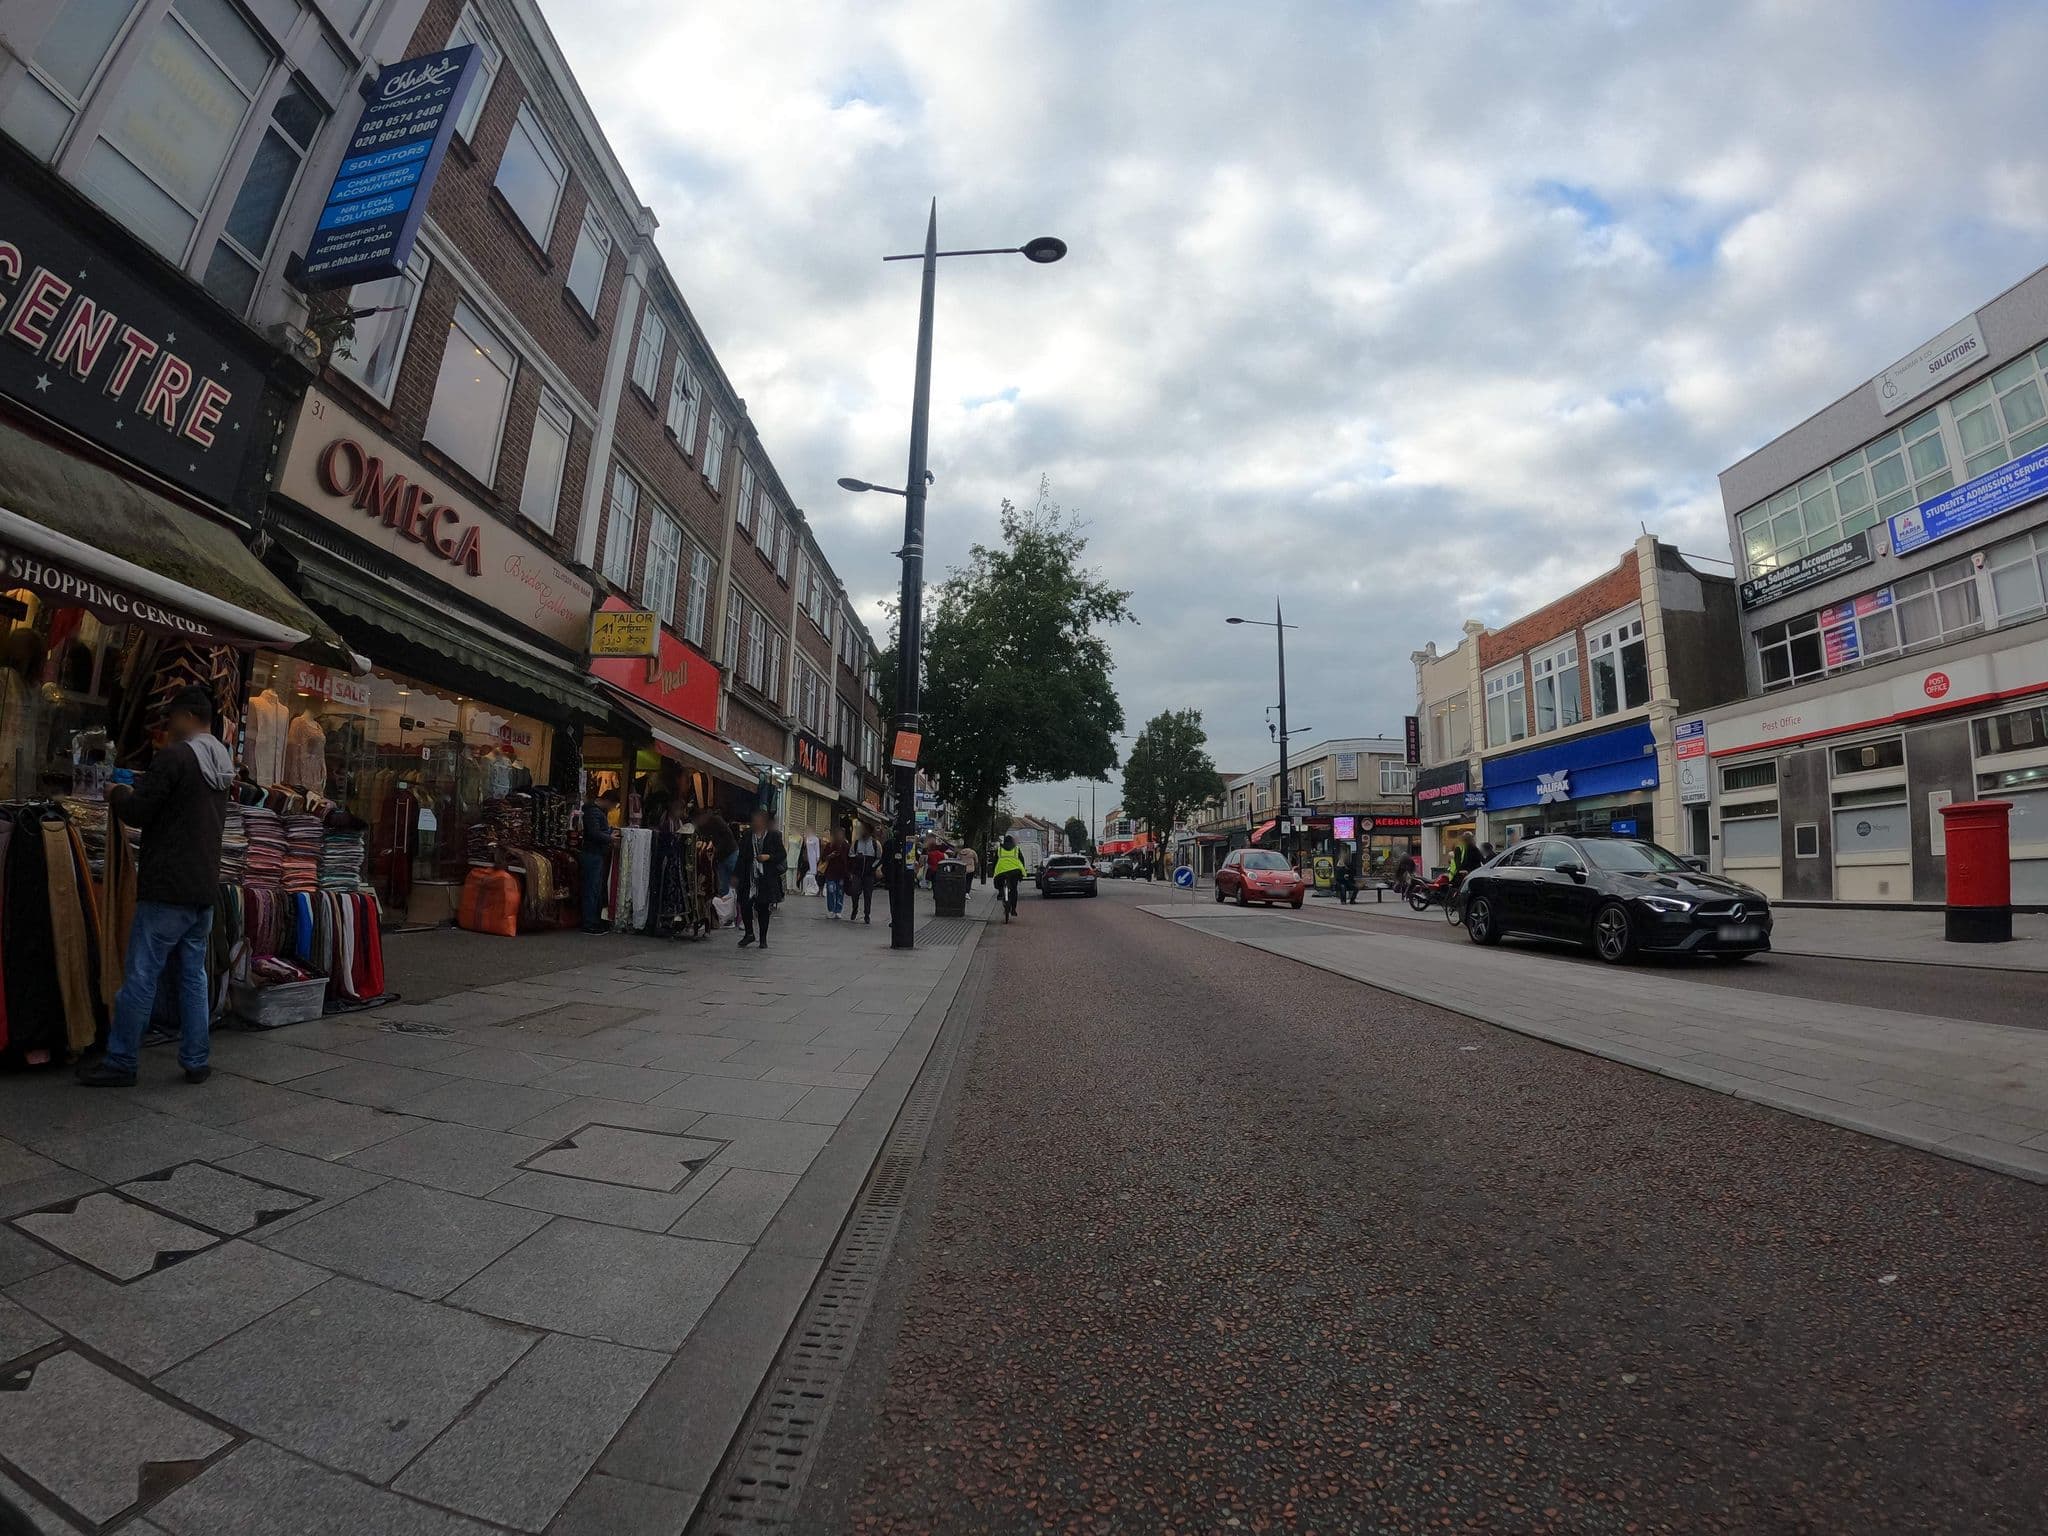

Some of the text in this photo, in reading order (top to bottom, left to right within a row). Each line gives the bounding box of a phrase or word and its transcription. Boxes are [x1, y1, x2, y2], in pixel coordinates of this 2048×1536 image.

[370, 95, 422, 113] CHHOKAR
[434, 87, 452, 96] CO
[355, 134, 376, 148] 020
[409, 119, 438, 134] 0000
[362, 119, 383, 132] 020
[385, 112, 413, 127] 8574
[349, 145, 425, 171] SOLICITORS
[336, 173, 416, 199] ACCOUNTANTS
[347, 168, 410, 189] CHARTERED
[334, 203, 395, 224] SOLUTIONS
[316, 231, 393, 255] HERBERT ROAD
[326, 227, 375, 243] Reception
[1928, 338, 1977, 374] SOLICITORS
[312, 400, 325, 420] 31
[317, 438, 482, 577] OMEGA
[1926, 494, 1966, 519] STUDENTS
[1966, 473, 2013, 502] ADMISSION
[1753, 579, 1767, 591] Tax
[1767, 564, 1800, 584] Solution
[1801, 542, 1853, 570] Accountants
[9, 557, 129, 613] SHOPPING
[612, 613, 653, 623] TAILOR
[299, 671, 331, 694] SALE
[1926, 683, 1948, 694] OFFICE
[1929, 676, 1945, 687] POST
[1762, 716, 1802, 732] Post Office
[1536, 779, 1570, 795] HALIFAX
